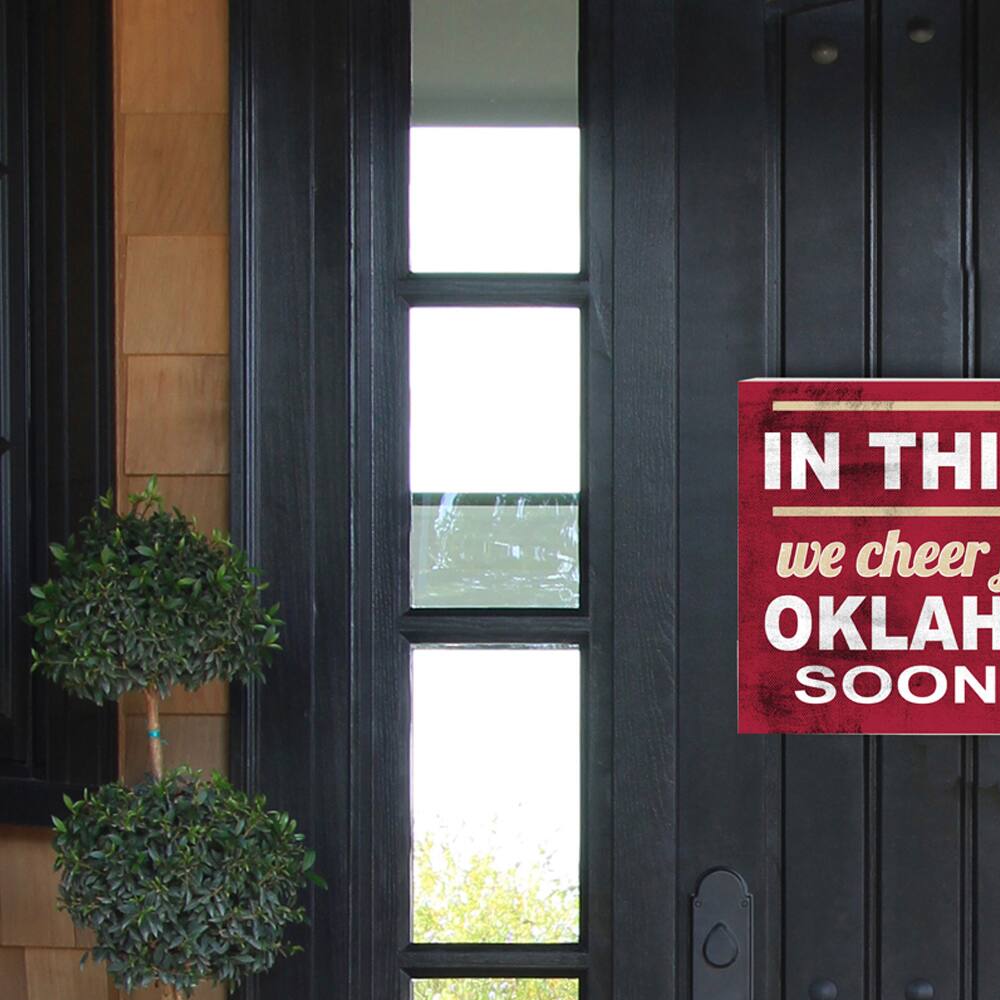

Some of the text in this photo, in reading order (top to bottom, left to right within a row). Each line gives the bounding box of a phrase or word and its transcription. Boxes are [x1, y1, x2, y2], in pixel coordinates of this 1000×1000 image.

[764, 431, 839, 490] IN
[776, 540, 841, 578] we
[856, 529, 990, 578] cheer
